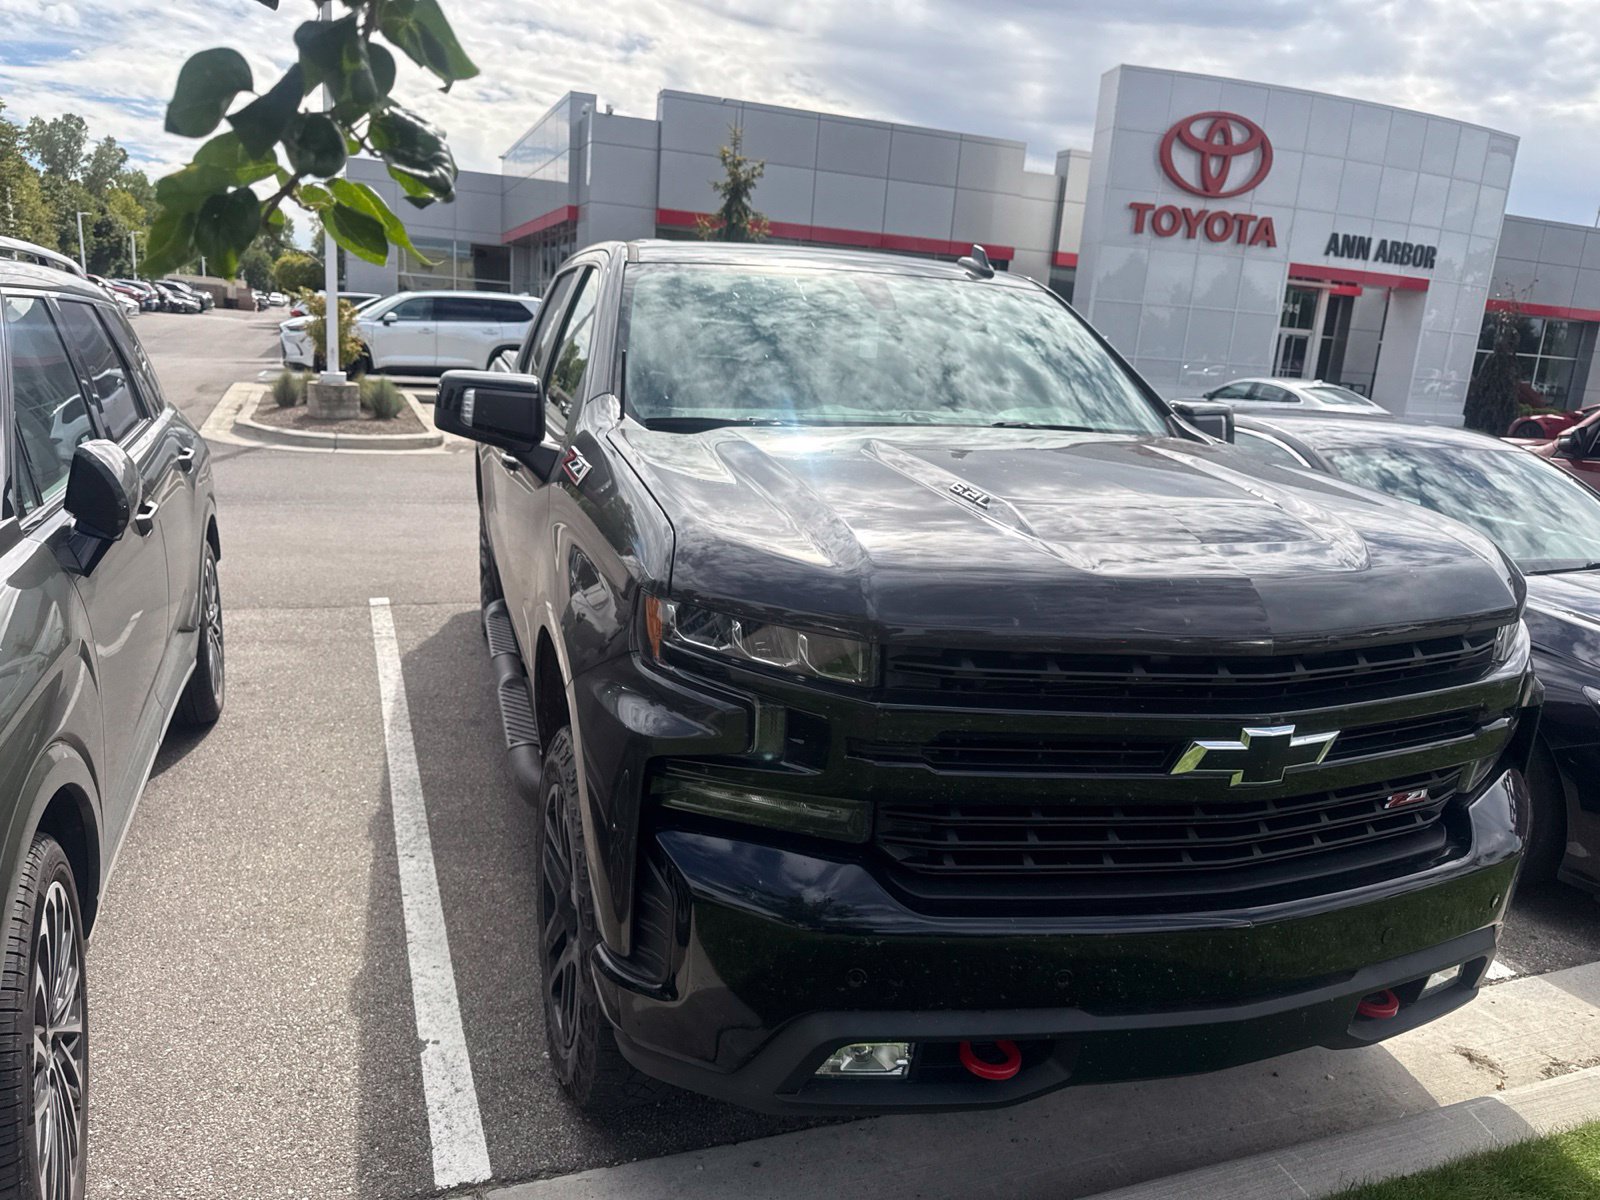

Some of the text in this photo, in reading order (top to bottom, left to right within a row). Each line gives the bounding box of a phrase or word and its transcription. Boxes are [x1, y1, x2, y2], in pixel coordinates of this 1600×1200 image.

[1129, 202, 1277, 248] TOYOTA
[1324, 232, 1437, 269] ANN ARBOR
[948, 480, 990, 510] 6.2L
